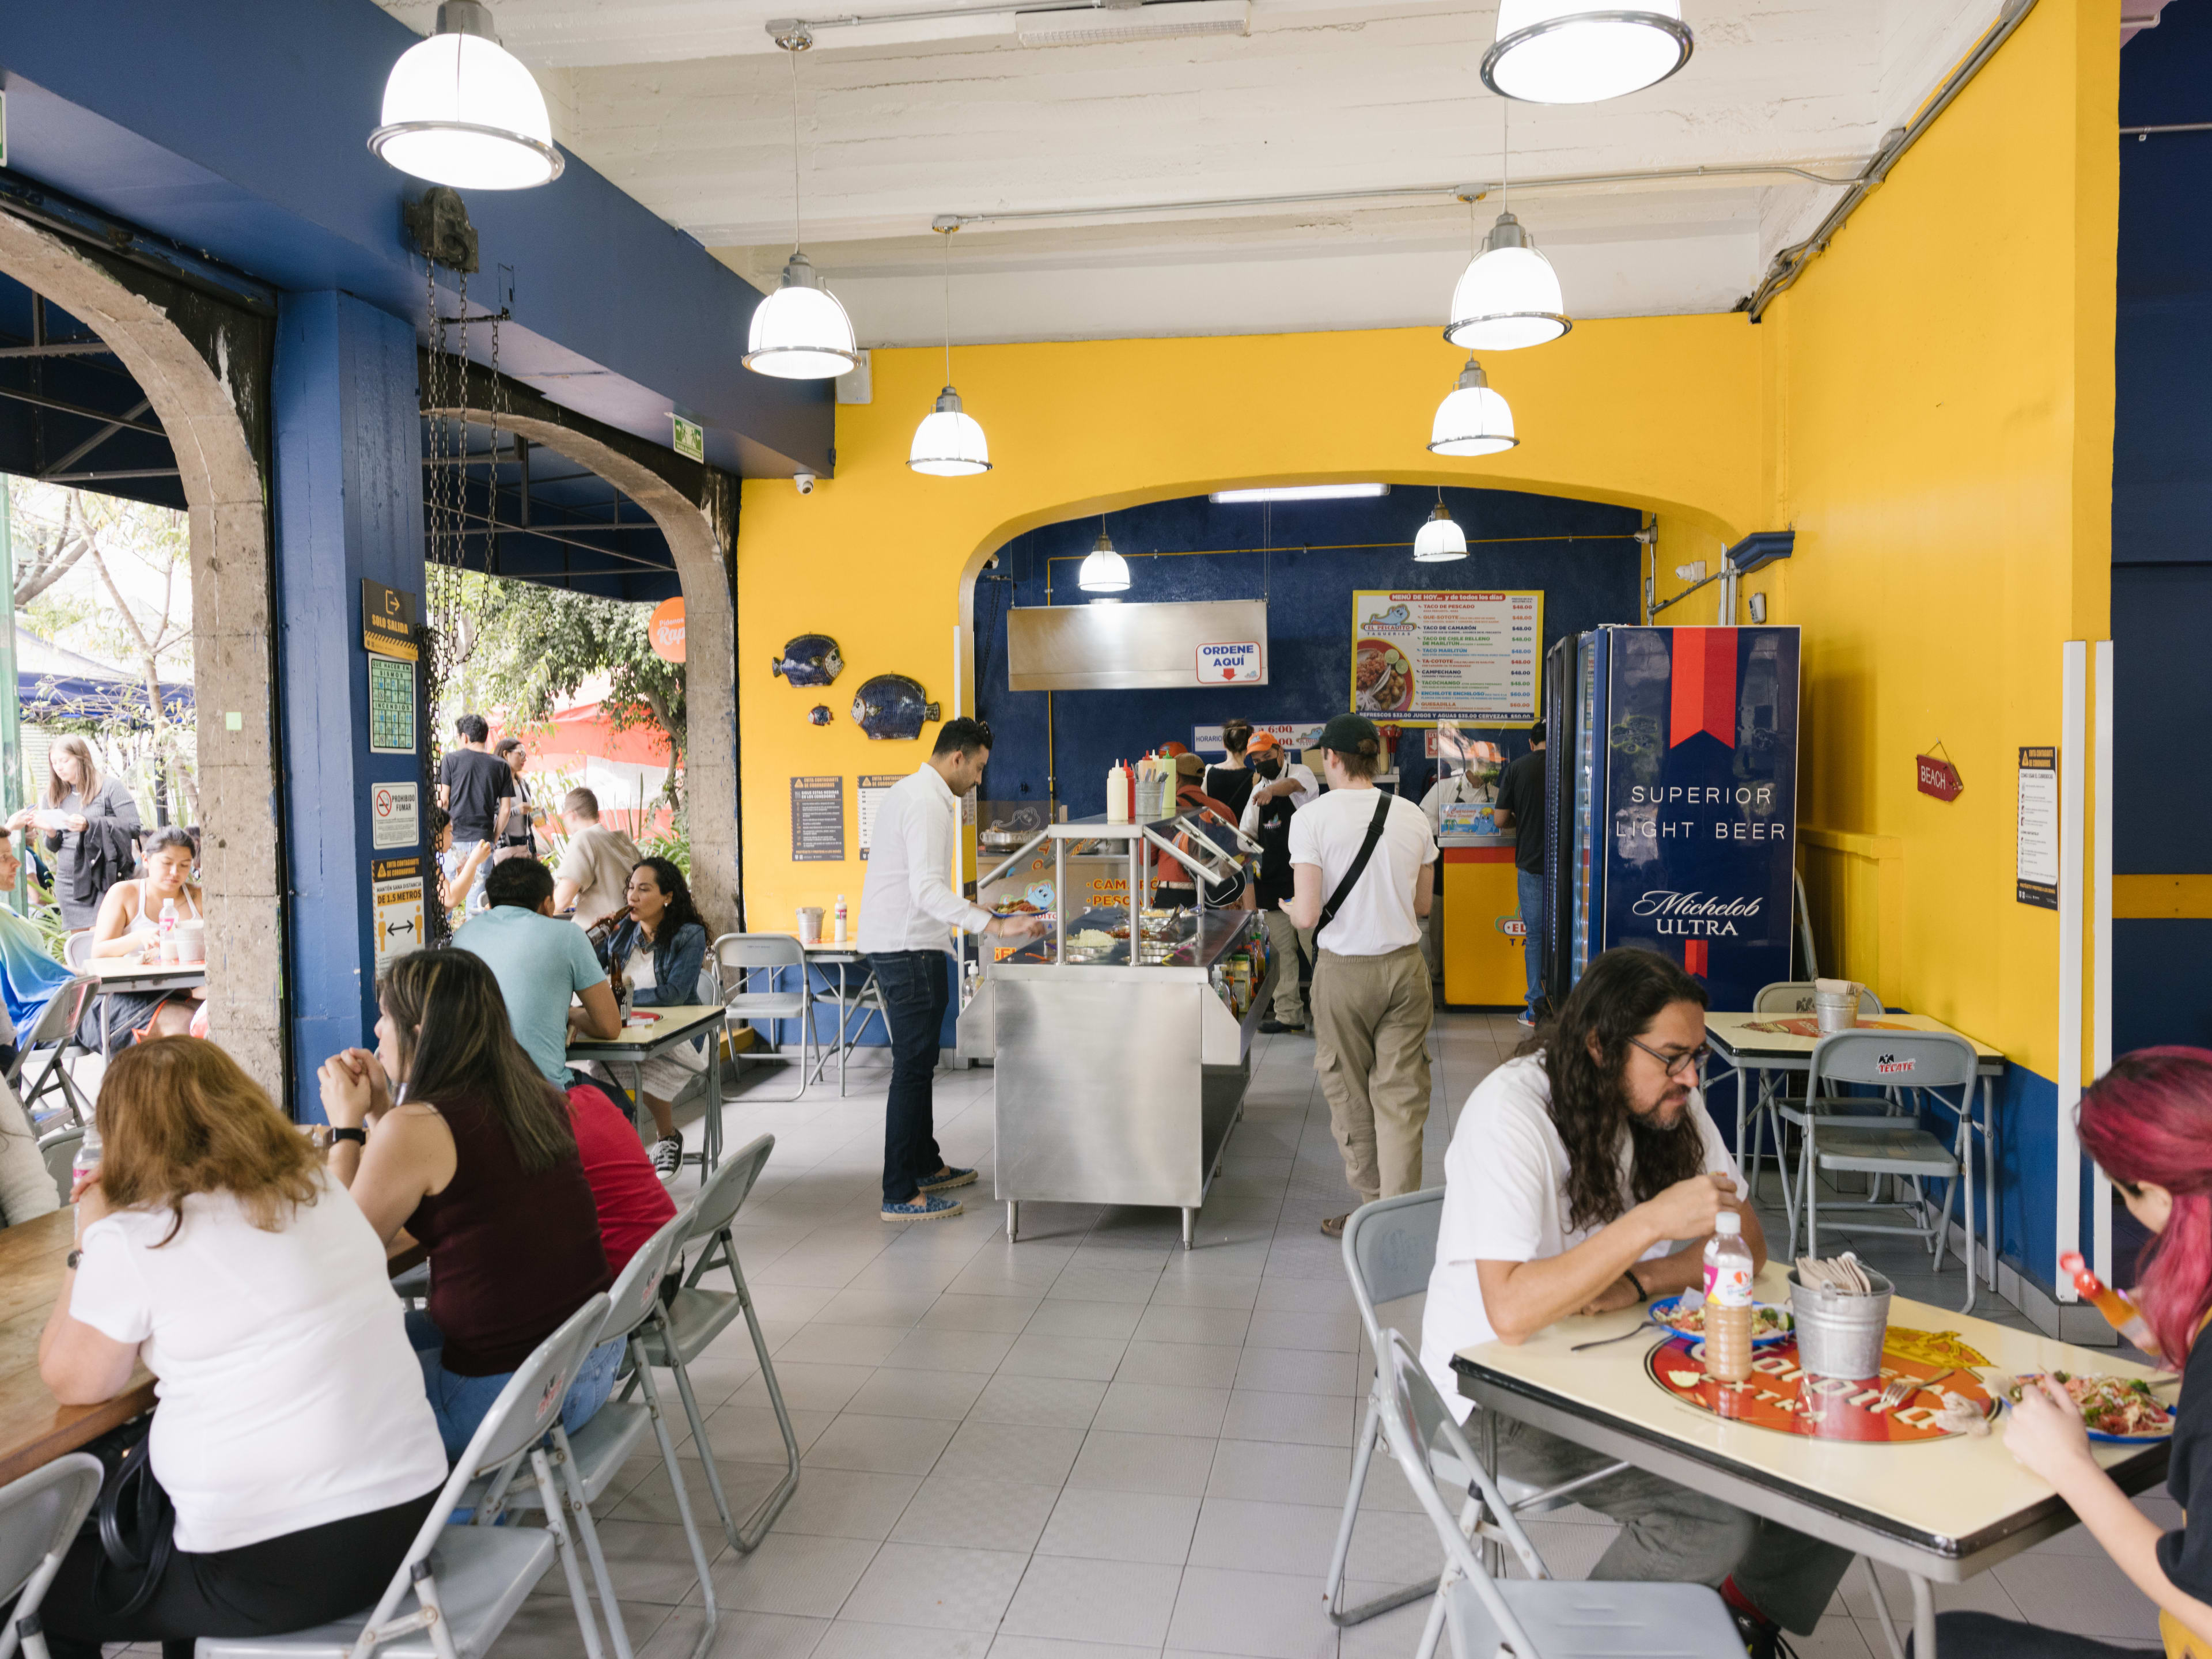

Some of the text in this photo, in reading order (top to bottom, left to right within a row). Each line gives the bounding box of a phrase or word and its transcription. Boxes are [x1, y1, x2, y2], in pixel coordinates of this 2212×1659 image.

[372, 613, 408, 635] SOLO SALIDA
[1203, 645, 1254, 655] ORDENE
[1213, 654, 1244, 666] AQUÍ
[1268, 725, 1292, 733] 6:00
[1921, 765, 1946, 790] BEACH
[1631, 786, 1771, 804] SUPERIOR
[1616, 821, 1785, 840] LIGHT BEER
[377, 890, 422, 904] DE 1.5 METROS
[1633, 890, 1764, 917] Michelob
[1656, 919, 1738, 936] ULTRA
[1878, 1061, 1915, 1073] TECATE
